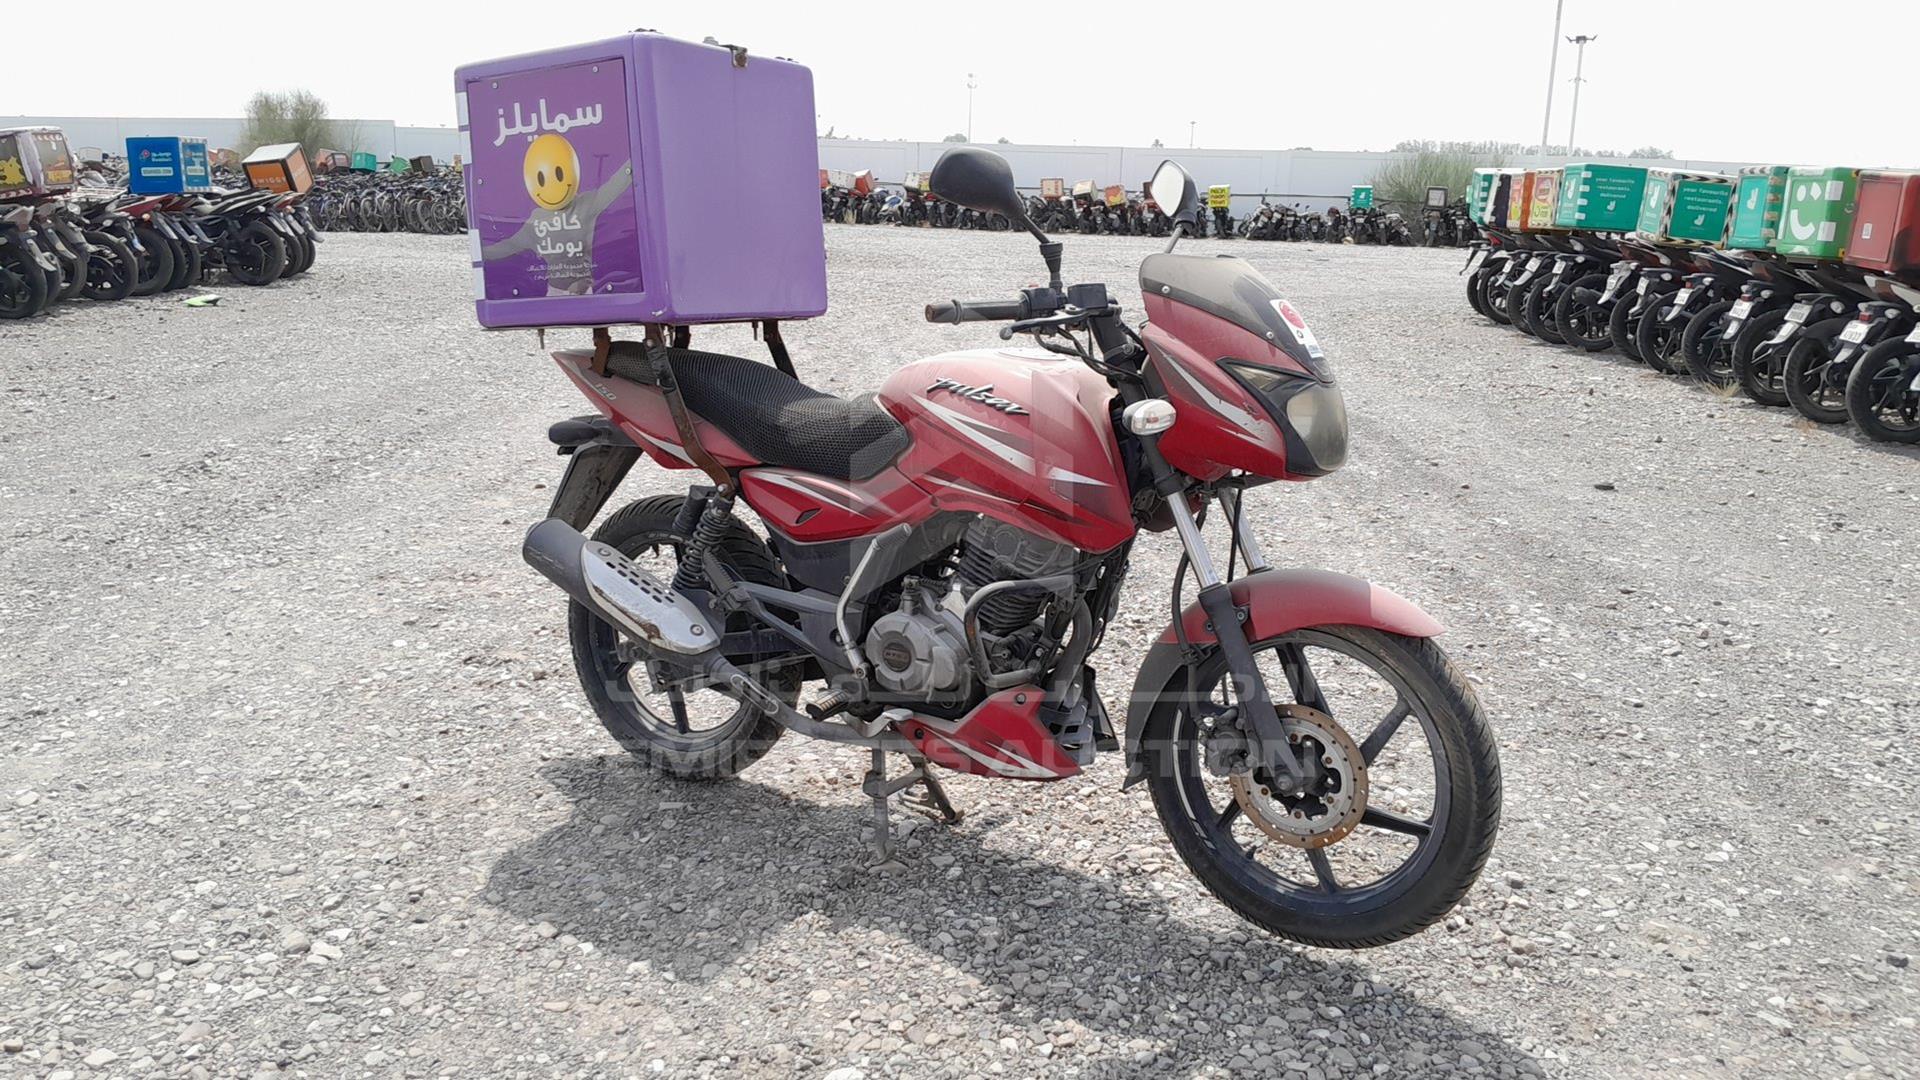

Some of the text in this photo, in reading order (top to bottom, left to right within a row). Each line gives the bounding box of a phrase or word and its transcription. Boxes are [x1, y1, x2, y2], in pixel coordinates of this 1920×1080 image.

[493, 99, 602, 147] سمايلز
[533, 212, 582, 237] كافئ
[536, 237, 583, 257] يومك
